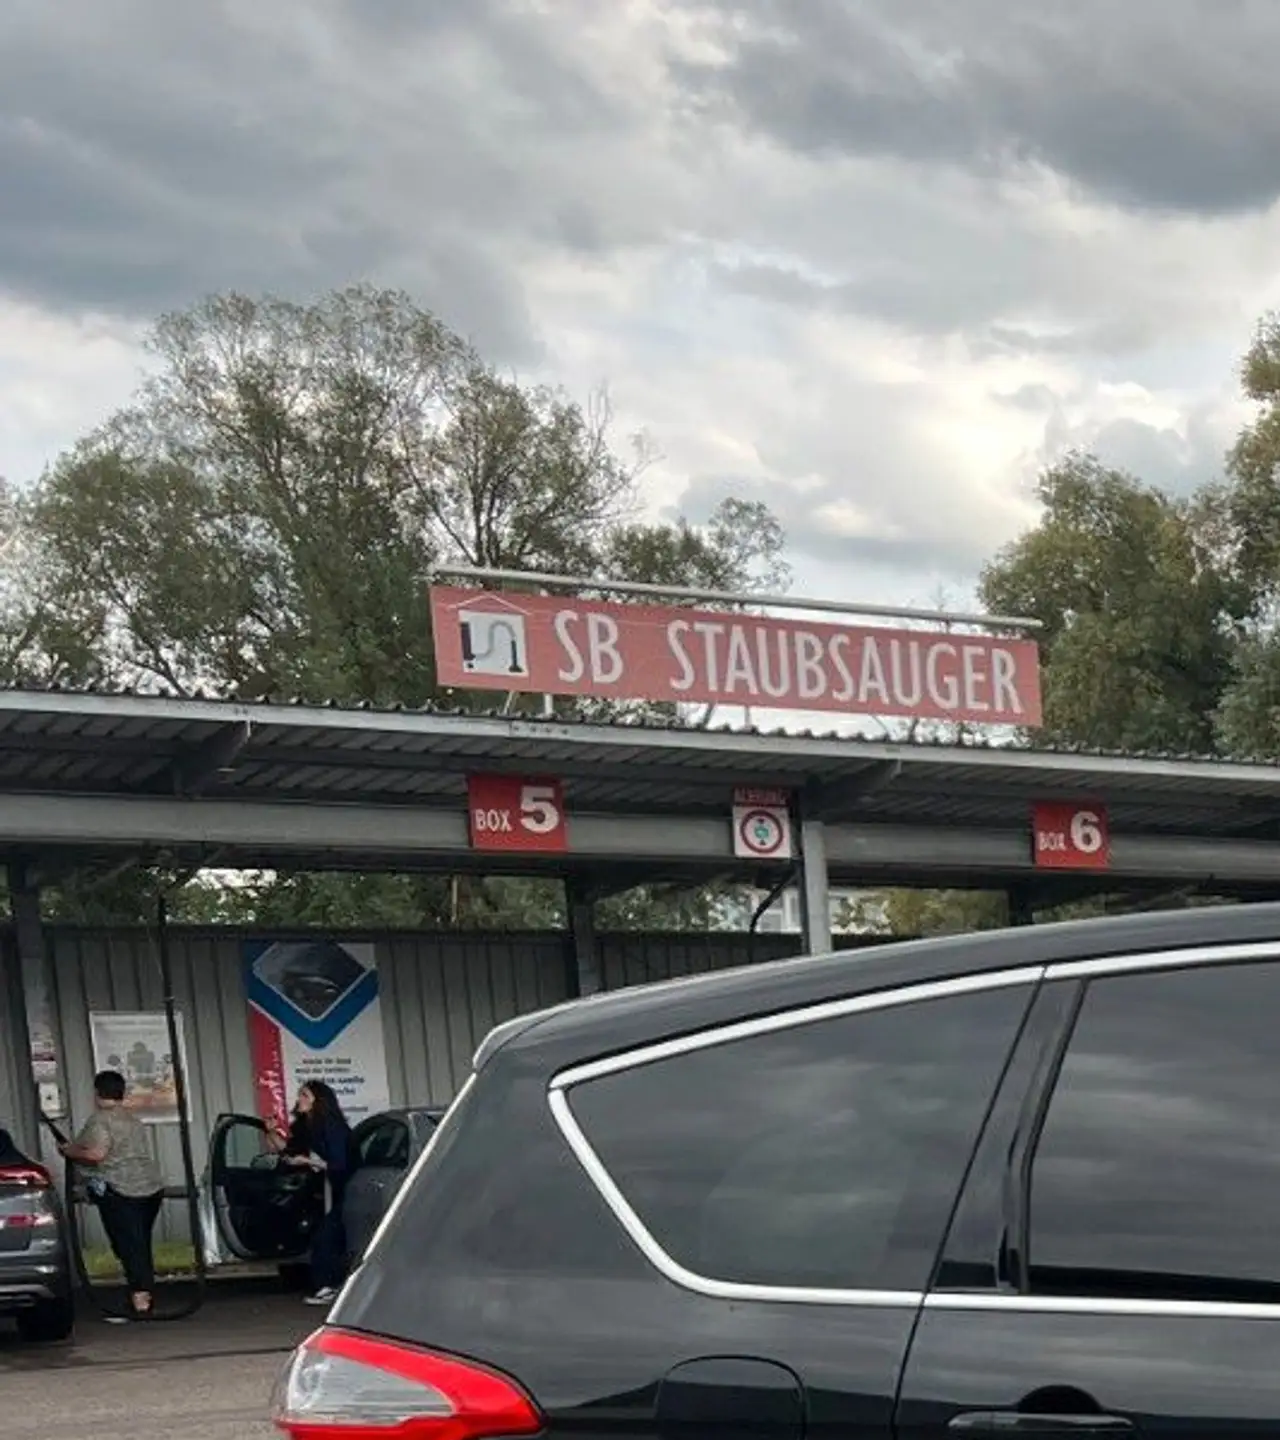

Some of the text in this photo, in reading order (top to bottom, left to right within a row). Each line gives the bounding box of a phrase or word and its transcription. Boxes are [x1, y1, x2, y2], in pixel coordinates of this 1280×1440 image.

[552, 609, 1024, 714] SB STAUBSAUGER
[475, 786, 560, 835] BOX 5
[1037, 810, 1103, 854] BOX 6
